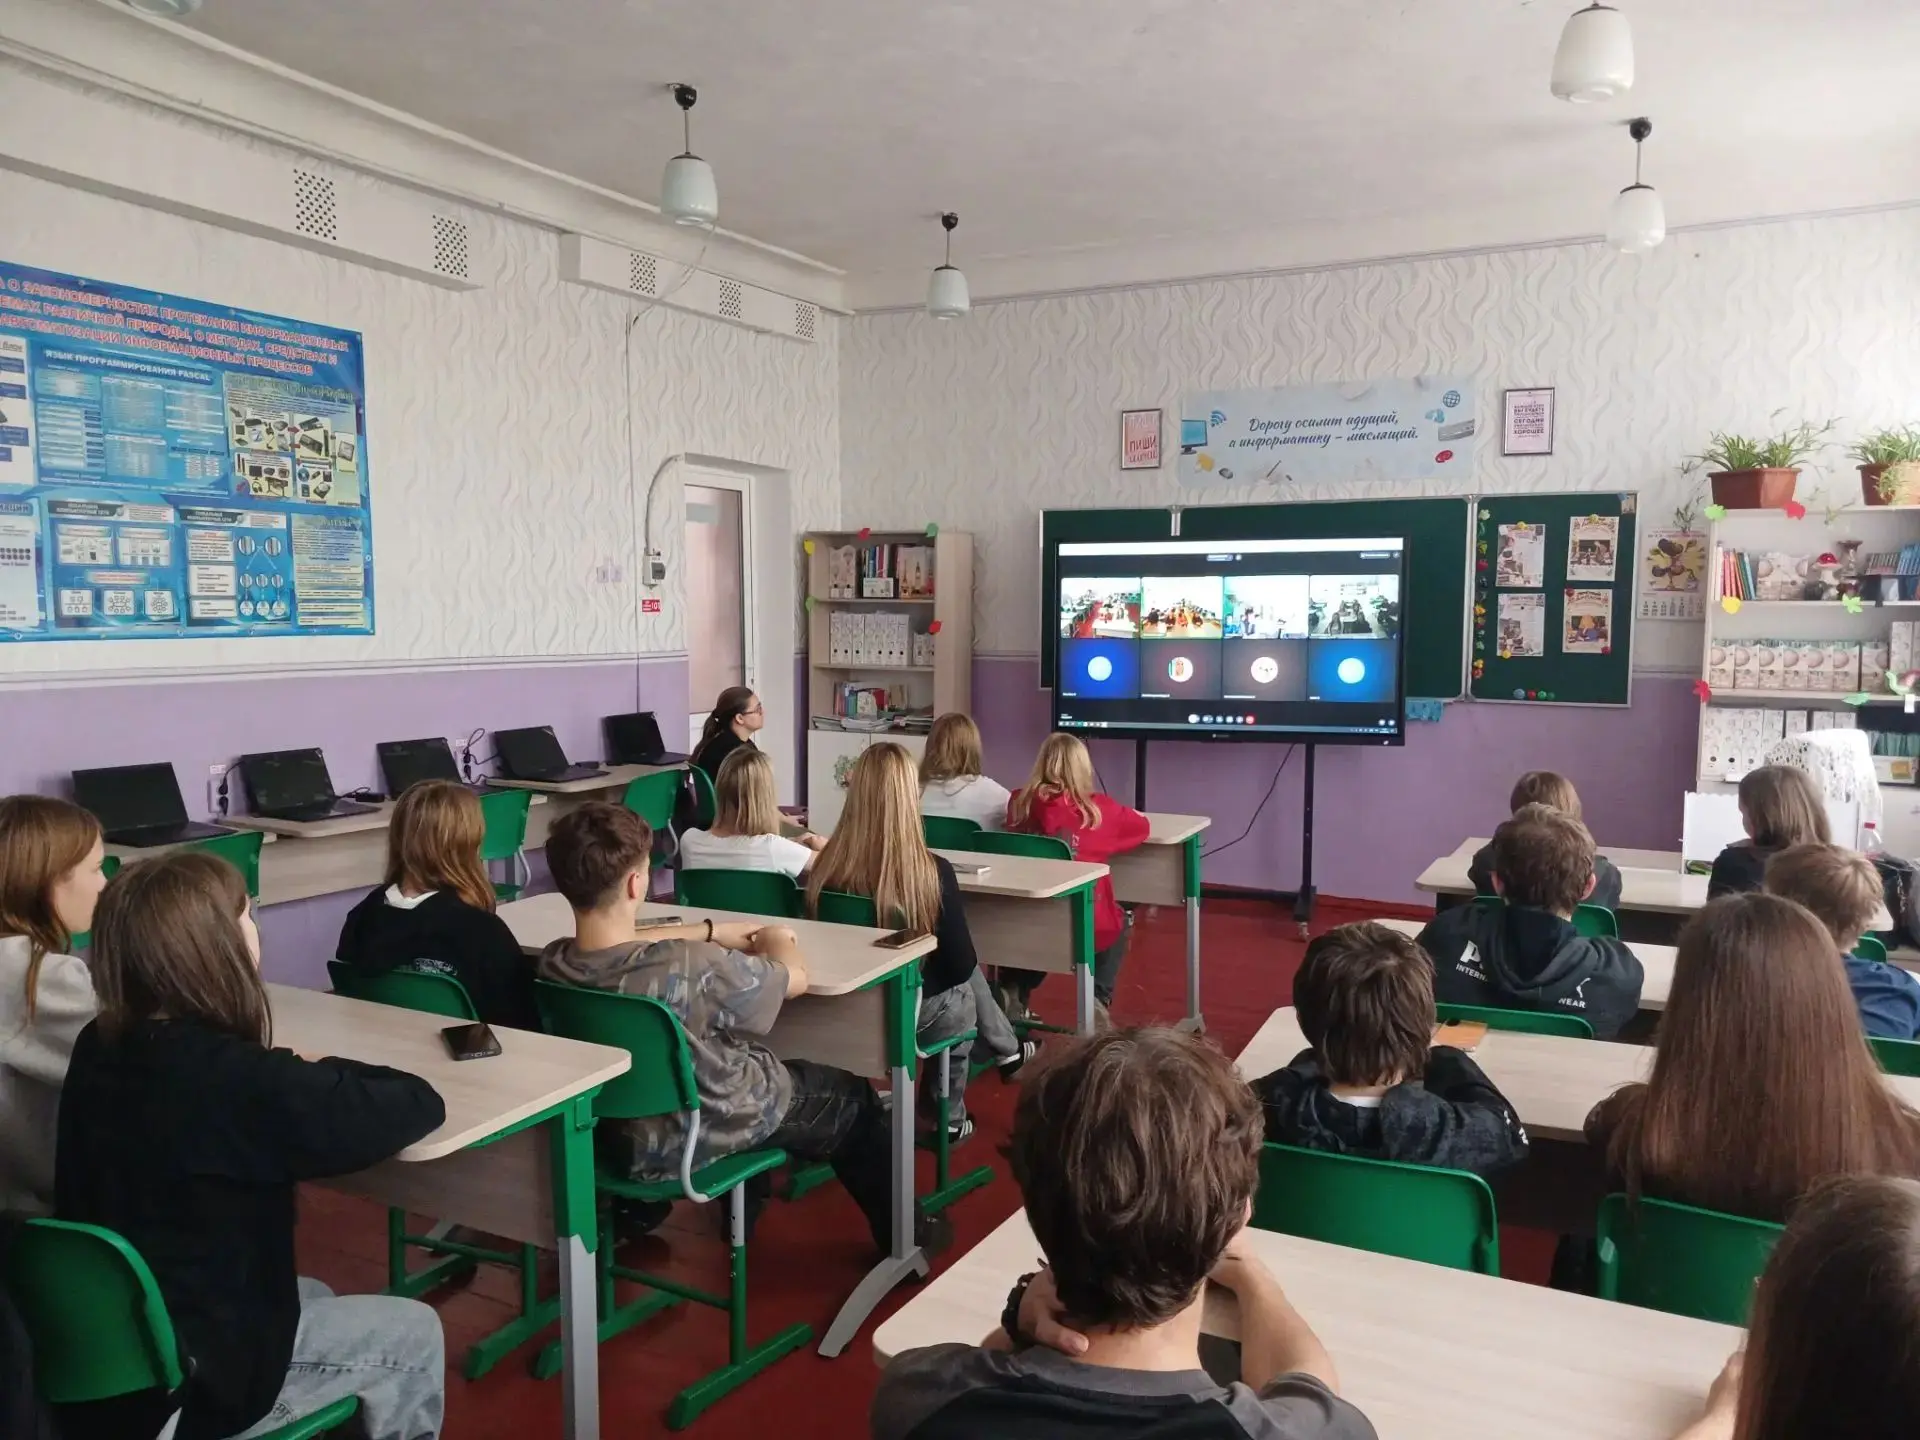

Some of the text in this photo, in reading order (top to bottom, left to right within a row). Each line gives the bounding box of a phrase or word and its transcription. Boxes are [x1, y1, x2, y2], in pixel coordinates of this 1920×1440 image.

[22, 281, 159, 318] ЗАКОНОМЕРНОСТЯХ
[160, 307, 239, 332] ПРОТЕКАНИЯ
[43, 302, 124, 328] РАЗЛИЧНОЙ
[45, 349, 72, 361] ЯЗЫК
[75, 354, 177, 376] ПРОГРАММИРОВАНИЯ
[247, 355, 314, 377] ПРОЦЕССОВ
[1249, 410, 1399, 435] Дорогу осилит идущий,
[1129, 434, 1156, 452] ПИШИ
[1228, 439, 1237, 448] а
[1239, 434, 1332, 451] информатику
[1347, 426, 1418, 443] мыслящий.
[1456, 963, 1487, 981] INTERN
